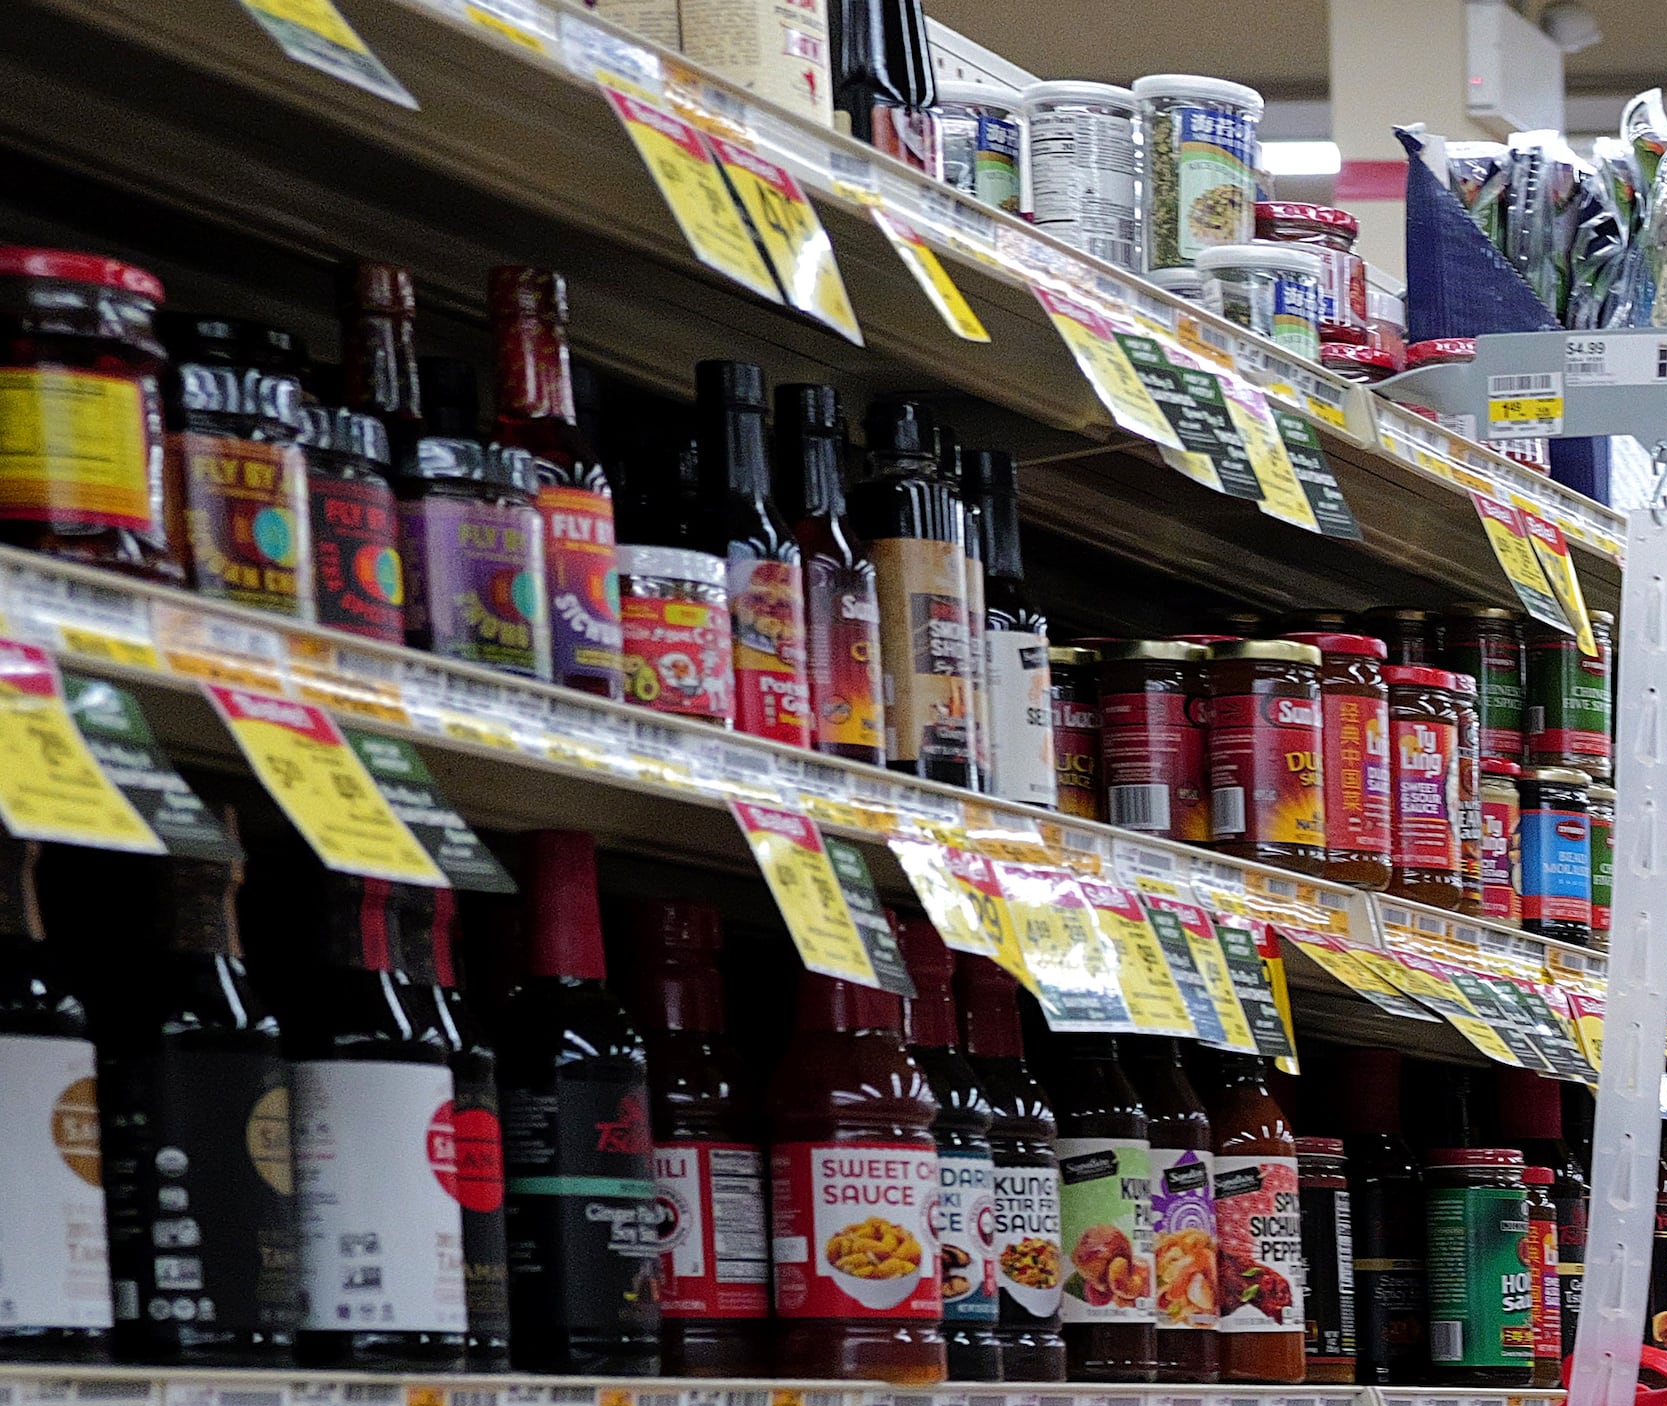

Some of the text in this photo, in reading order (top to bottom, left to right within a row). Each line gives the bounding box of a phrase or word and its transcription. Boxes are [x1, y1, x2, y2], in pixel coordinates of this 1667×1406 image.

[1566, 341, 1606, 356] $4.99
[552, 514, 594, 539] FLY
[1414, 725, 1437, 753] Ty
[1402, 748, 1443, 780] Ling
[1402, 804, 1439, 814] SAUCE
[822, 1160, 909, 1178] SWEET
[824, 1185, 915, 1205] SAUCE
[994, 1177, 1053, 1196] KUNG
